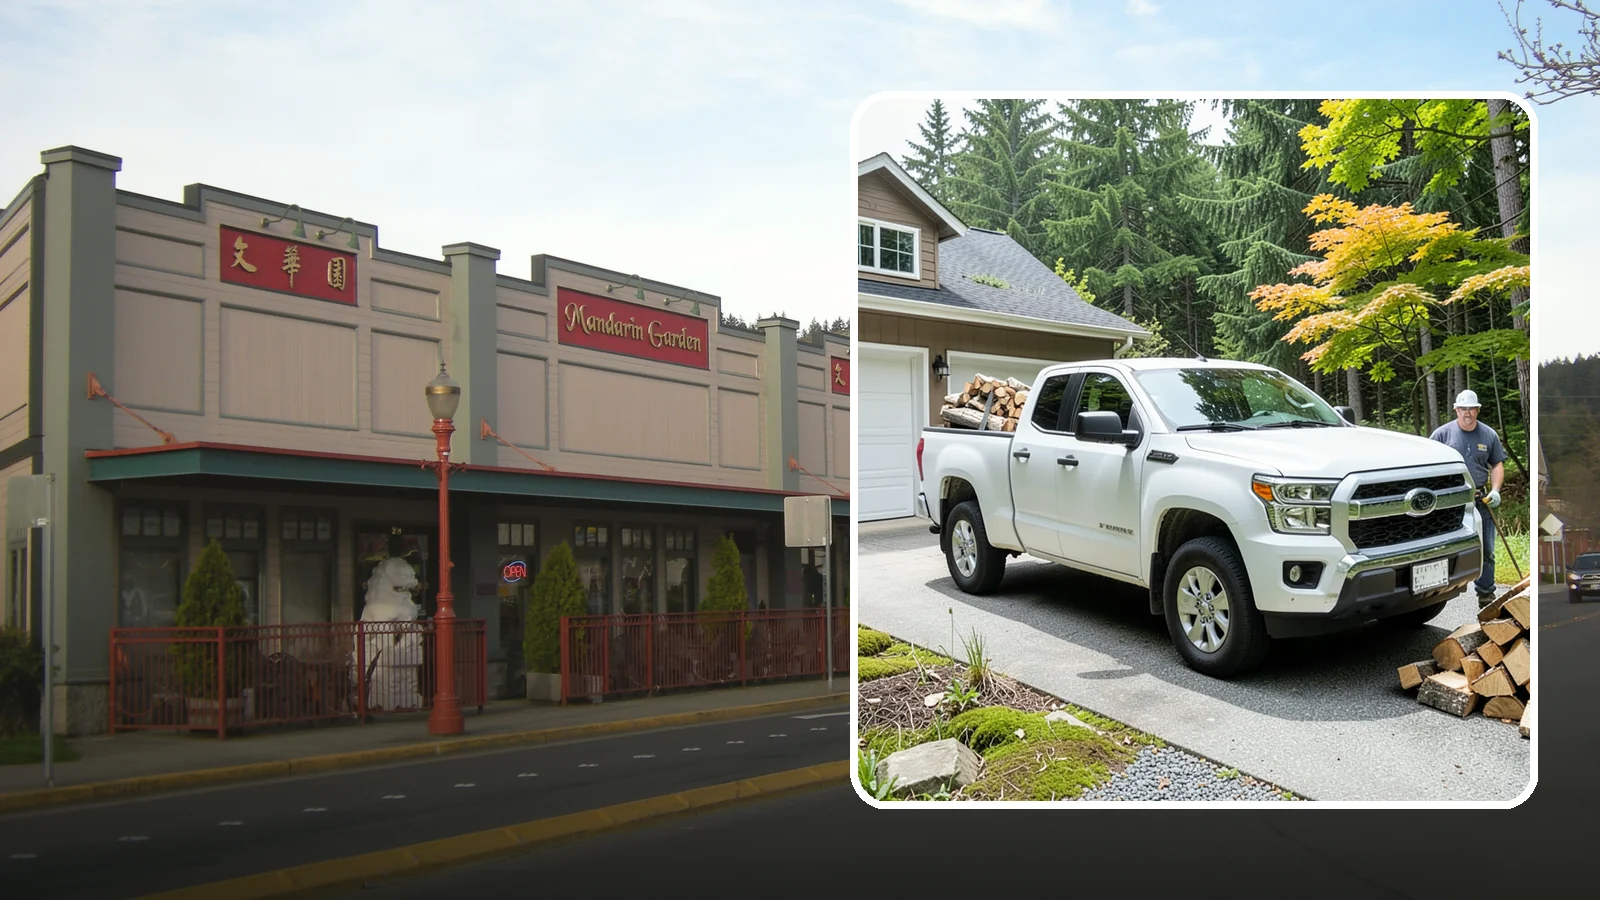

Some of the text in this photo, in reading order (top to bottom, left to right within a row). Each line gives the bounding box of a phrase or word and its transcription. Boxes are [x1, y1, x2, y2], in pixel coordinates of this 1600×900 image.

[230, 235, 346, 291] 文華園
[564, 302, 702, 352] Mandarin Garden
[503, 565, 527, 578] OPEN
